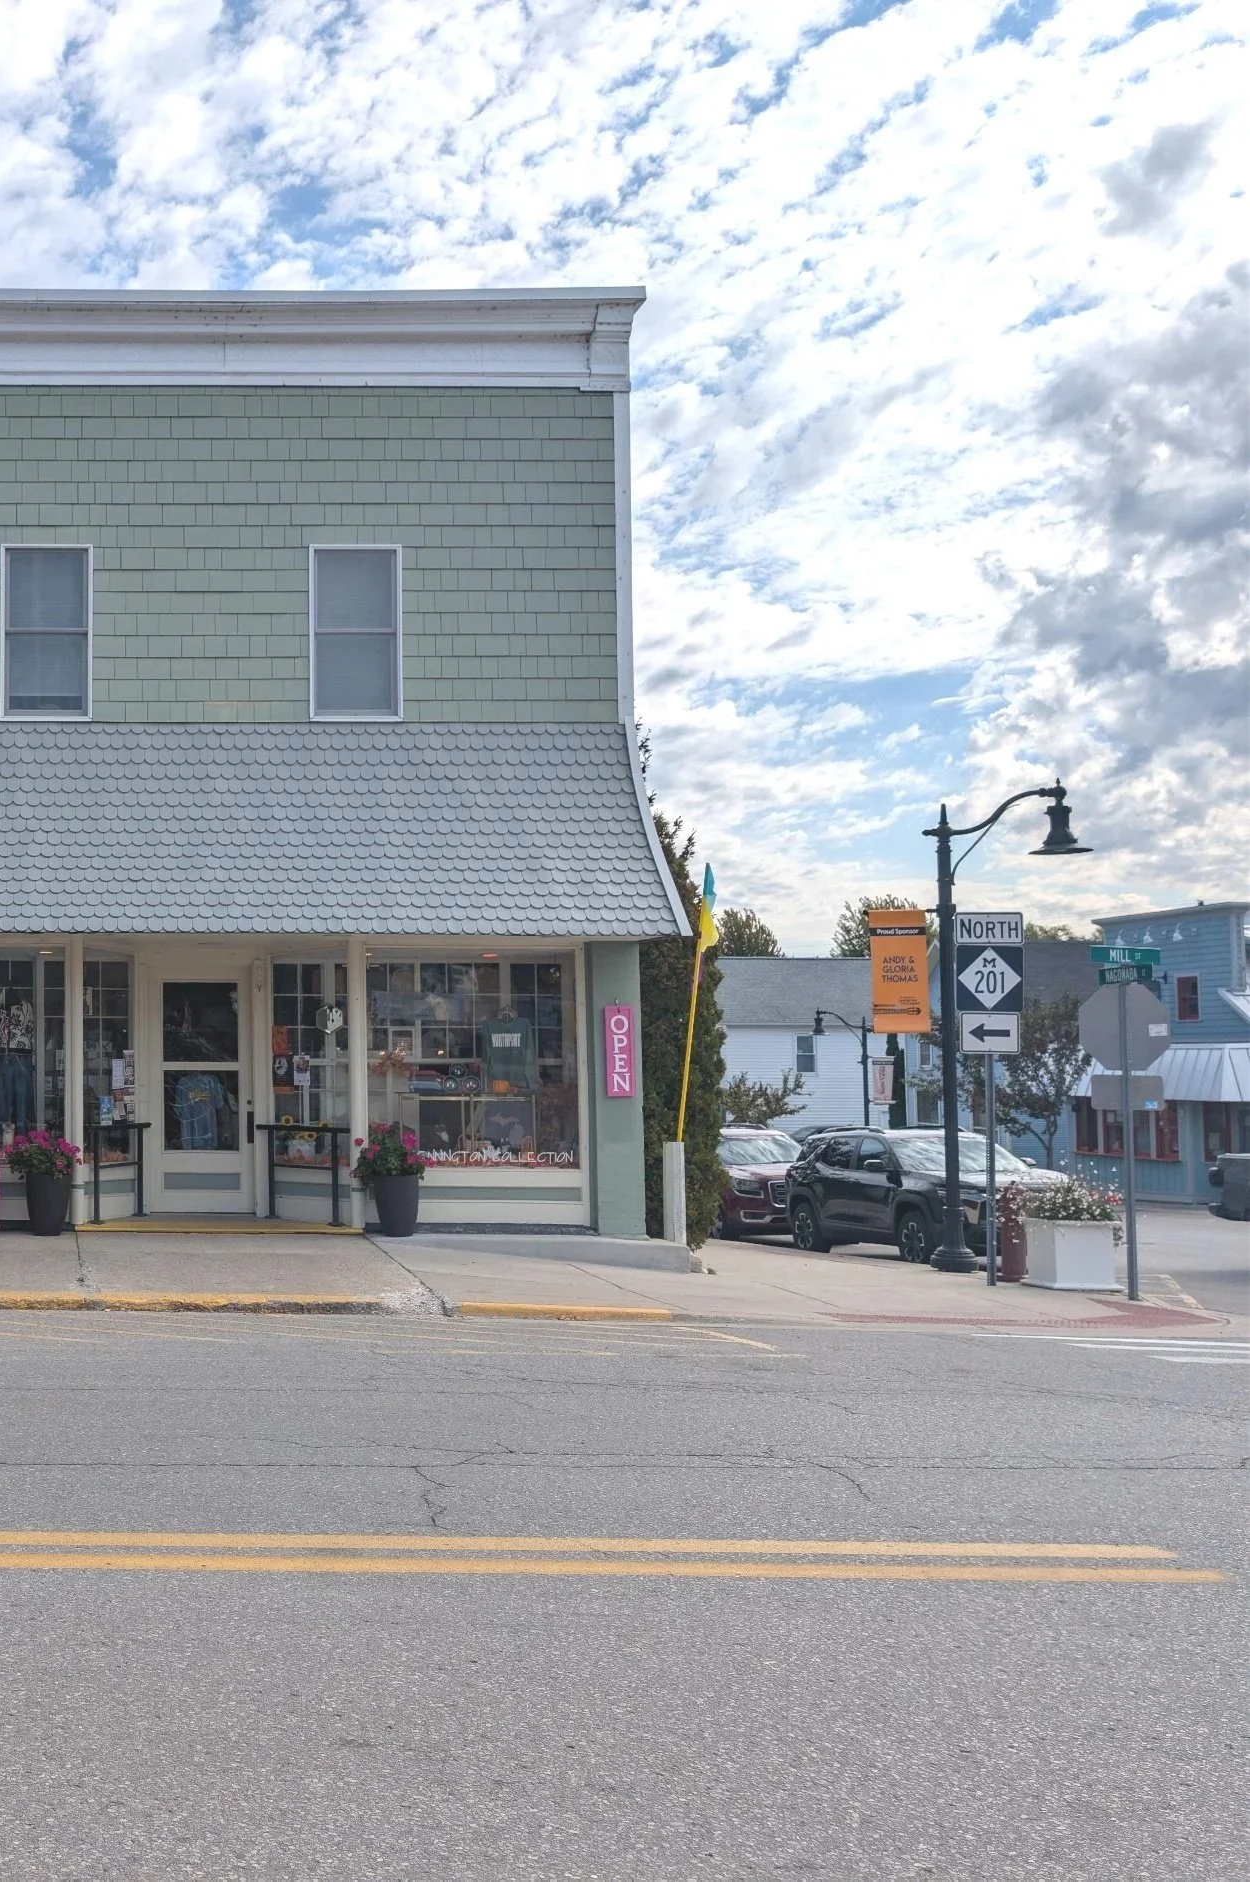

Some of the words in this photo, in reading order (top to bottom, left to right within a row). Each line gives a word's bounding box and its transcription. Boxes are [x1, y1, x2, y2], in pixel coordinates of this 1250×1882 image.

[895, 928, 919, 936] Sponsor
[959, 919, 1019, 939] NORTH
[882, 956, 905, 964] ANDY
[908, 956, 915, 964] &
[1109, 949, 1131, 962] MILL
[1134, 952, 1142, 960] ST
[882, 965, 915, 973] GLORIA
[982, 957, 997, 968] M
[881, 974, 919, 983] THOMAS
[1105, 967, 1138, 983] NAGONABA
[974, 970, 1005, 994] 201
[610, 1014, 631, 1092] OPEN
[492, 1150, 574, 1165] COLLECTION
